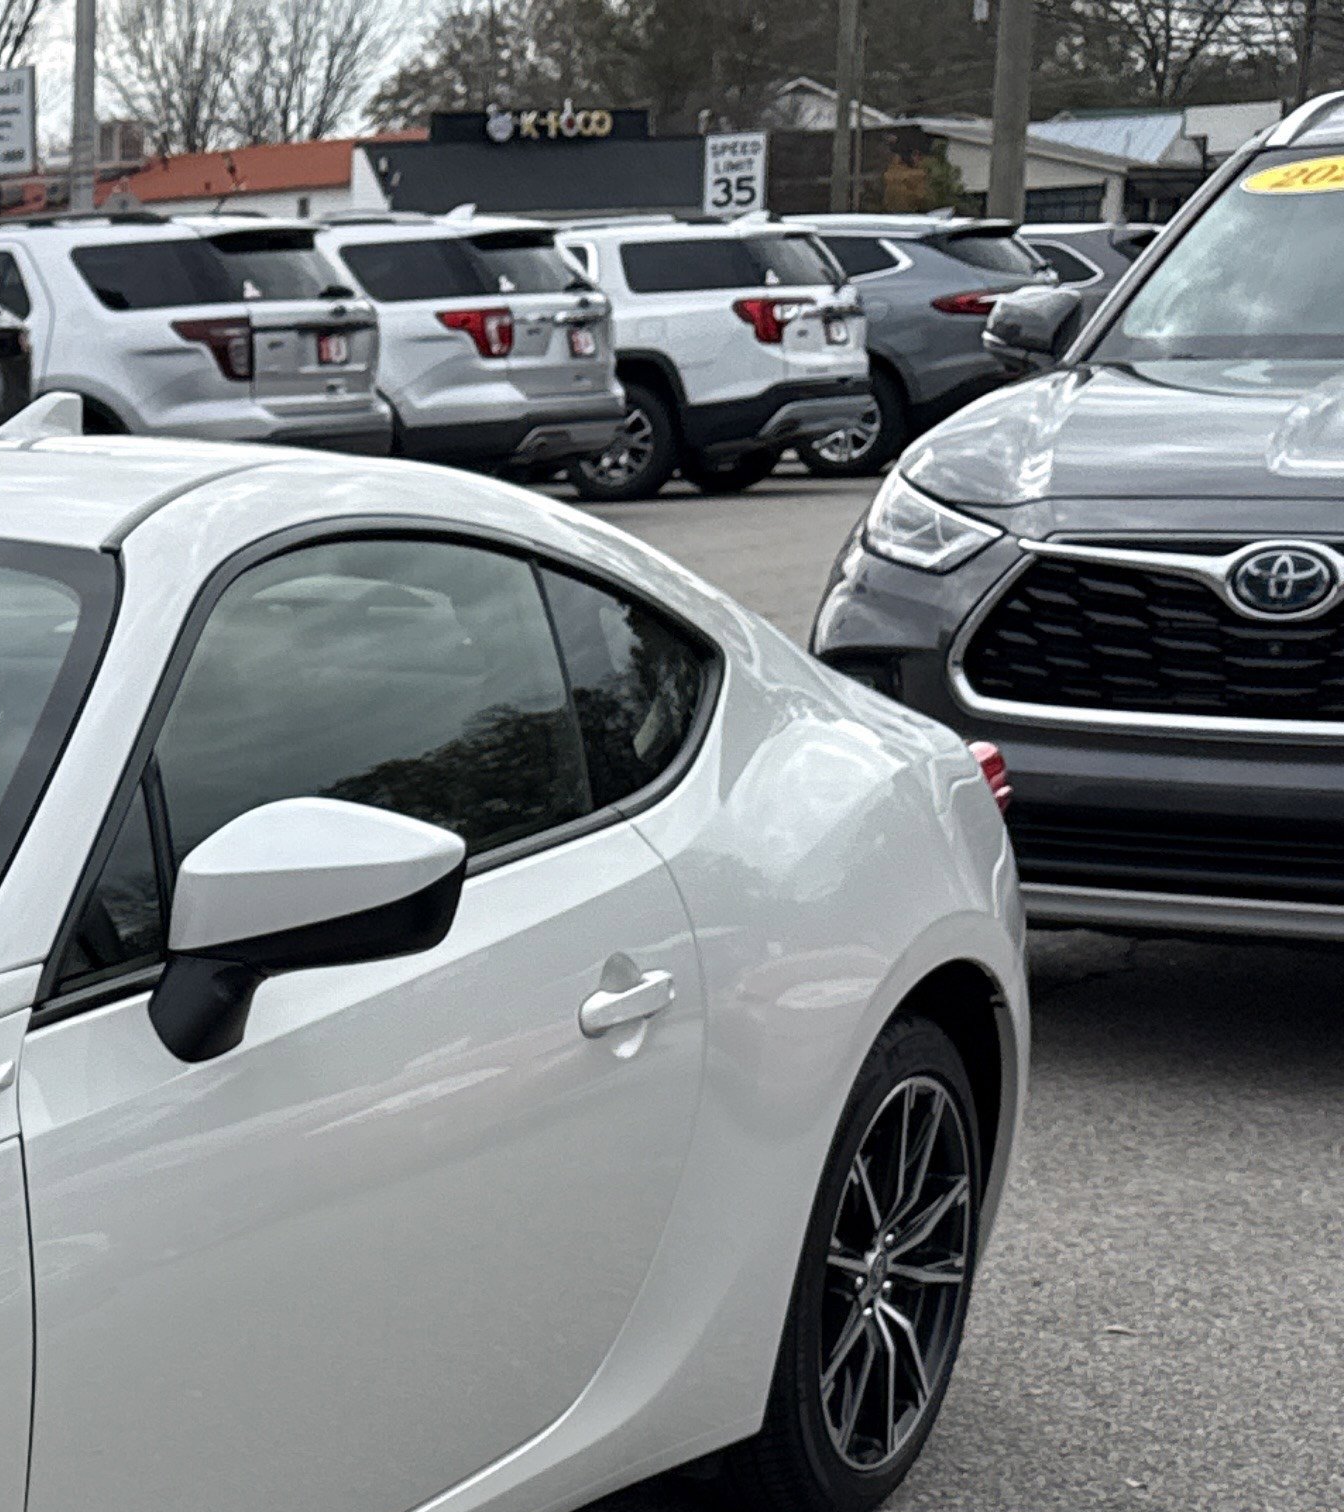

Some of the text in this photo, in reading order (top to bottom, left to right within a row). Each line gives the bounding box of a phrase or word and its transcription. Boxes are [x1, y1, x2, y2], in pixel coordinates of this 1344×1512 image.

[711, 141, 762, 158] SPEED
[713, 158, 755, 175] LIMIT
[711, 175, 757, 208] 35
